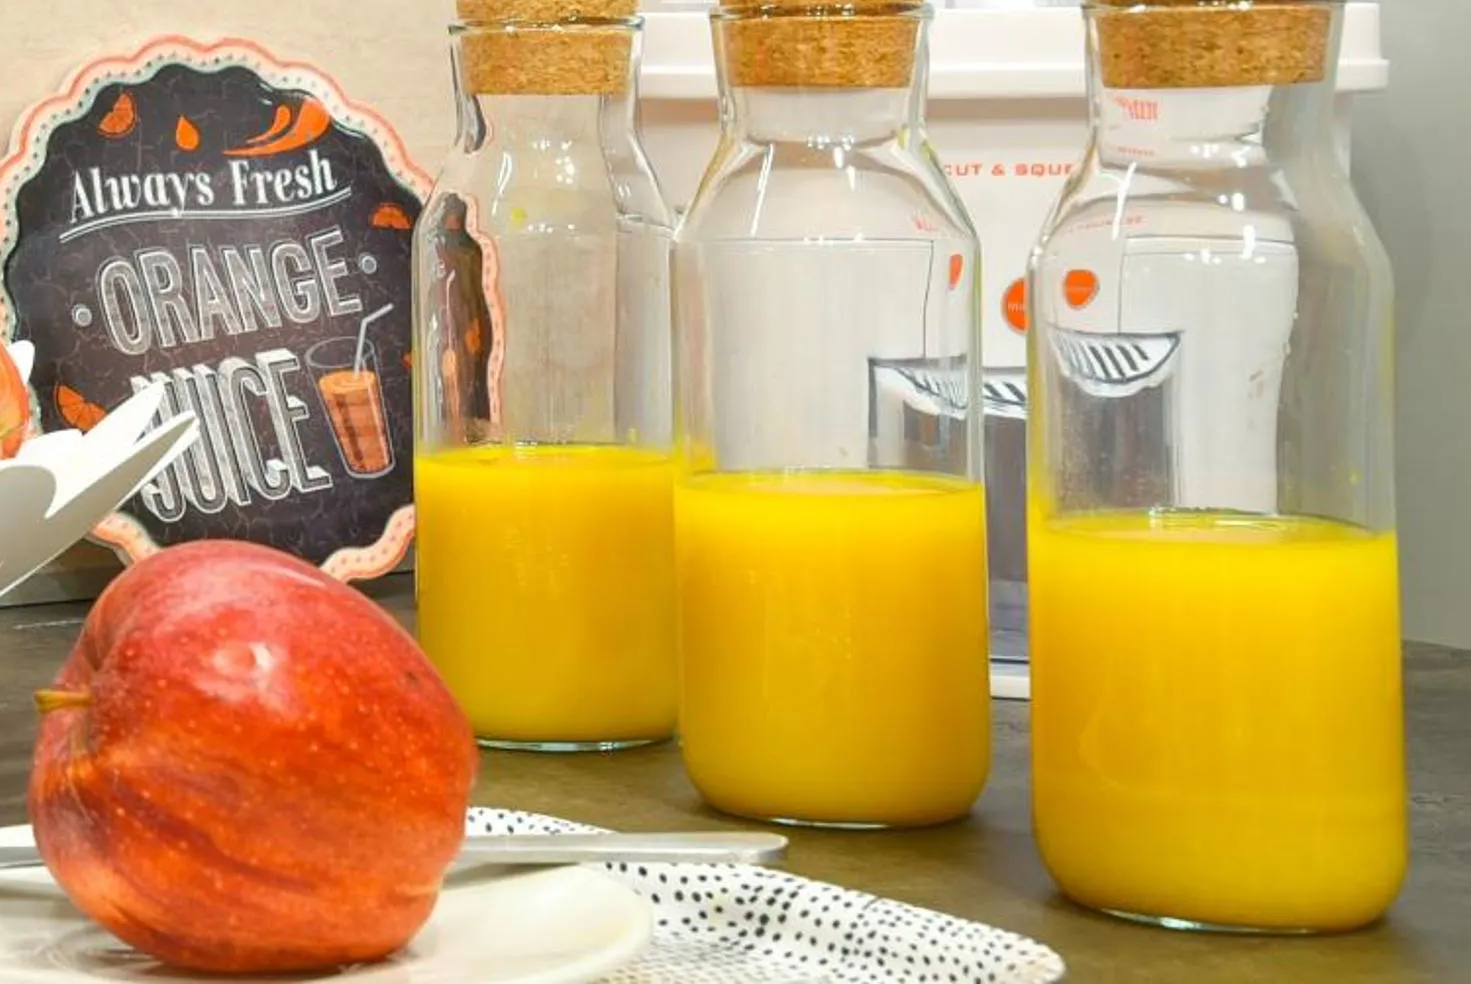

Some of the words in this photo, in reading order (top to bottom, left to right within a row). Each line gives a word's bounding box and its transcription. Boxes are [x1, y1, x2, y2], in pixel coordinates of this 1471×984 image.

[70, 167, 214, 223] Always
[230, 148, 338, 205] Fresh
[991, 163, 1005, 177] &
[96, 225, 363, 356] ORANGE
